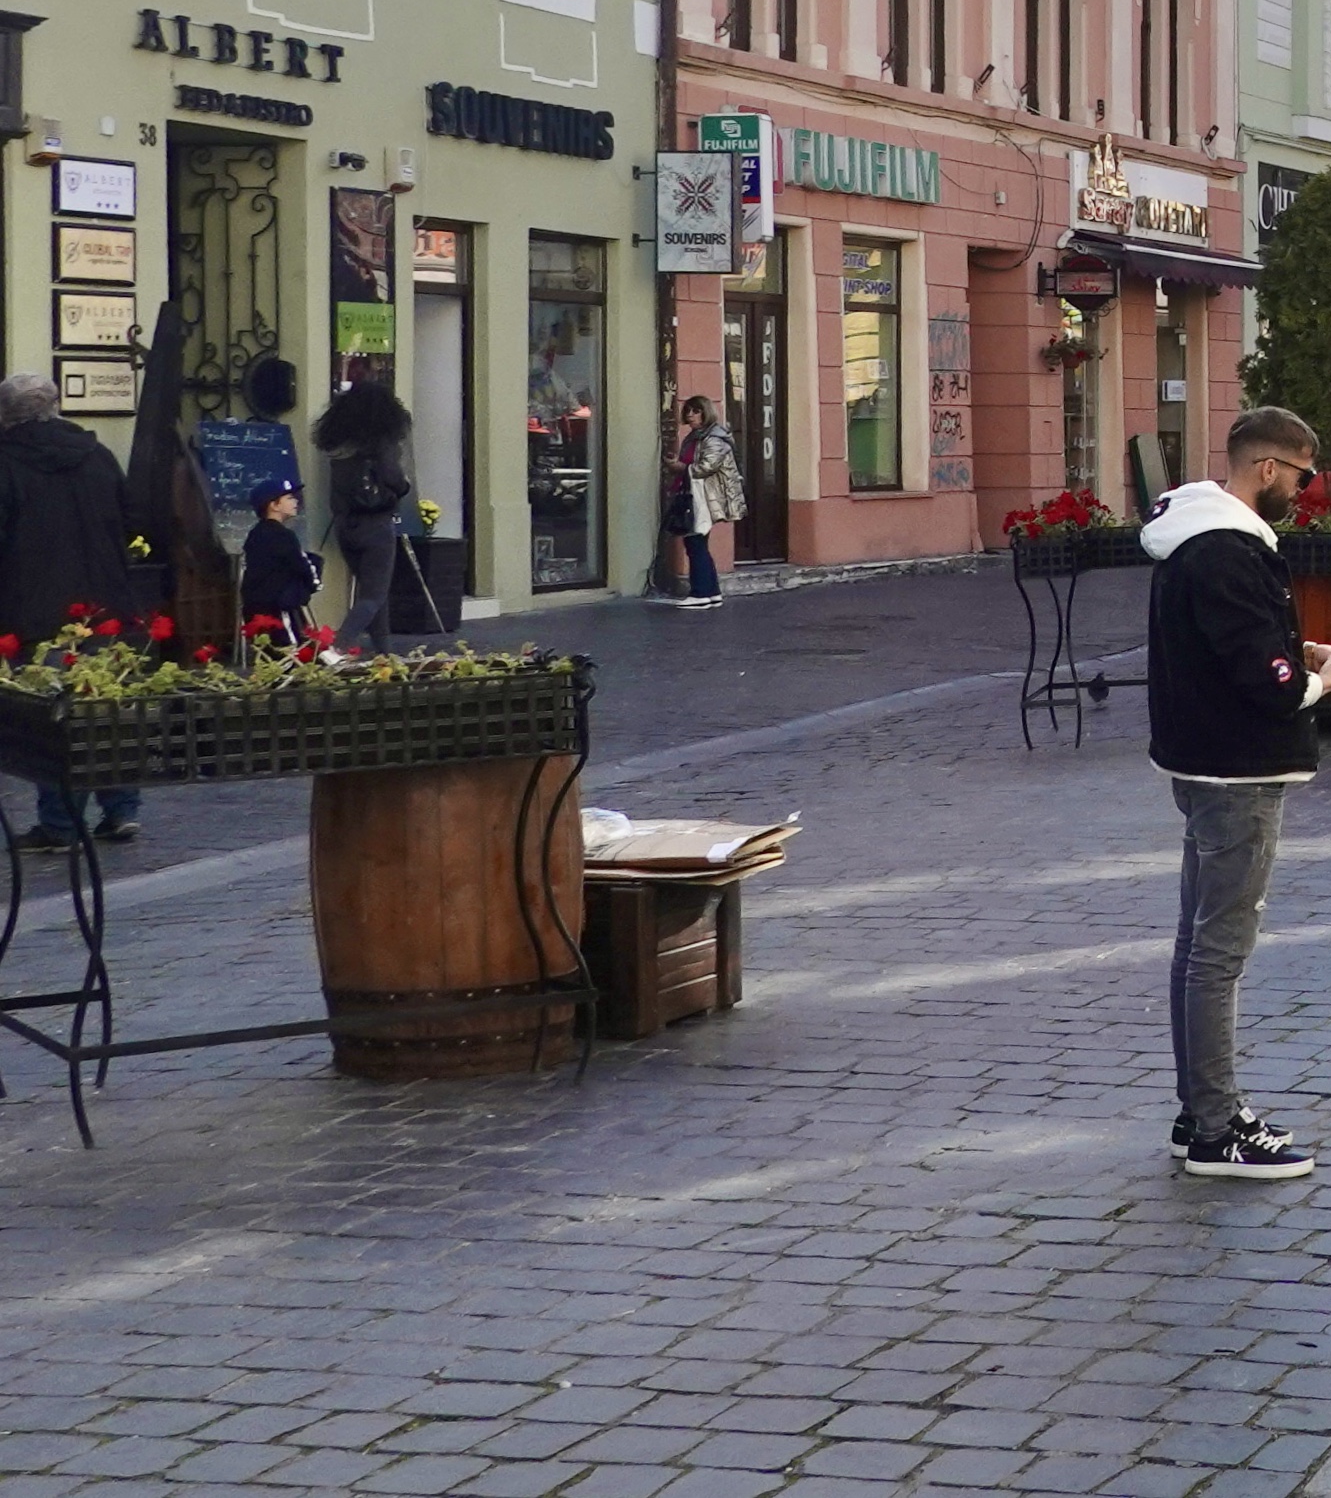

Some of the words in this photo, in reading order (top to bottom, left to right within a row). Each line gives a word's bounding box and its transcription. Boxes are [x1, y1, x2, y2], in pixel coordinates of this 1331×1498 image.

[134, 8, 345, 83] ALBERT
[425, 82, 615, 161] SOUVENIRS
[139, 122, 157, 146] 38
[704, 139, 759, 150] FUJIFILM
[793, 128, 941, 203] FUJIFILM
[665, 232, 727, 245] SOUVENIRS
[865, 281, 893, 295] SHOP
